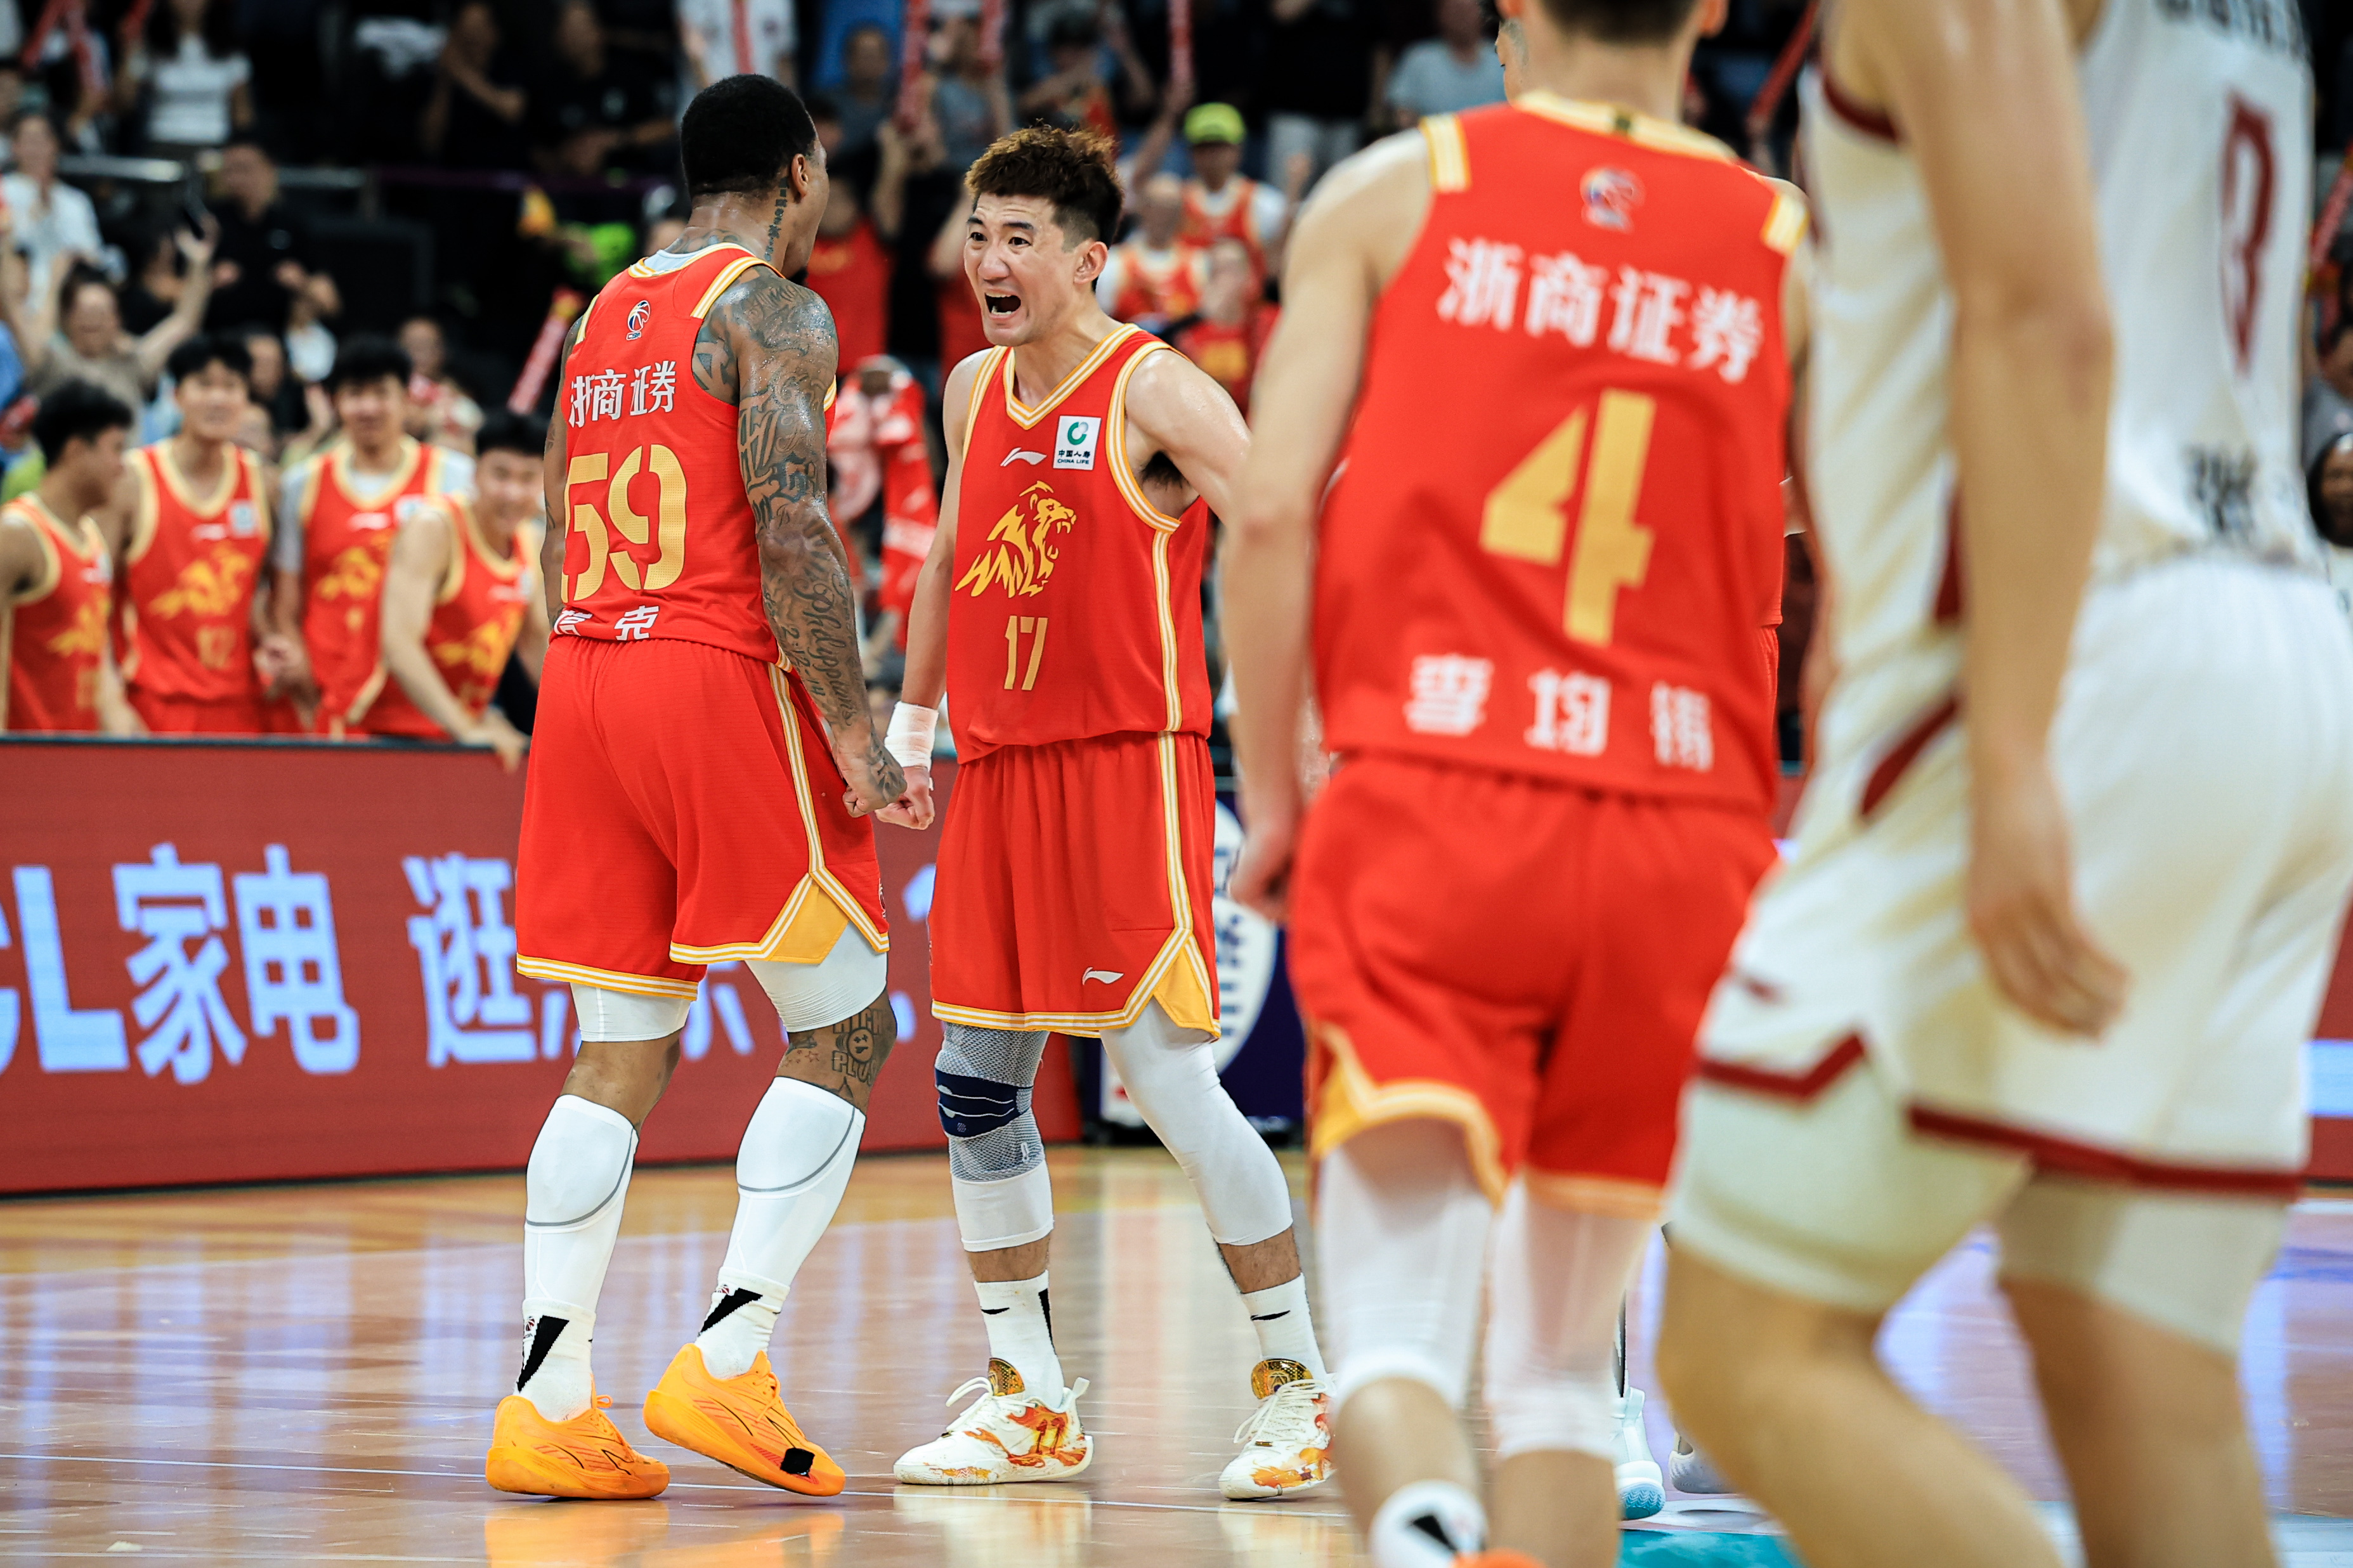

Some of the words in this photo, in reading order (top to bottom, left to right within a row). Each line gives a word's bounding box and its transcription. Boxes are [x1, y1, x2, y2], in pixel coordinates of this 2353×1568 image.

[561, 444, 687, 603] 59
[1058, 450, 1091, 458] 中国人寿
[1480, 387, 1656, 647] 4
[1004, 615, 1048, 690] 17
[0, 842, 360, 1085] L家电
